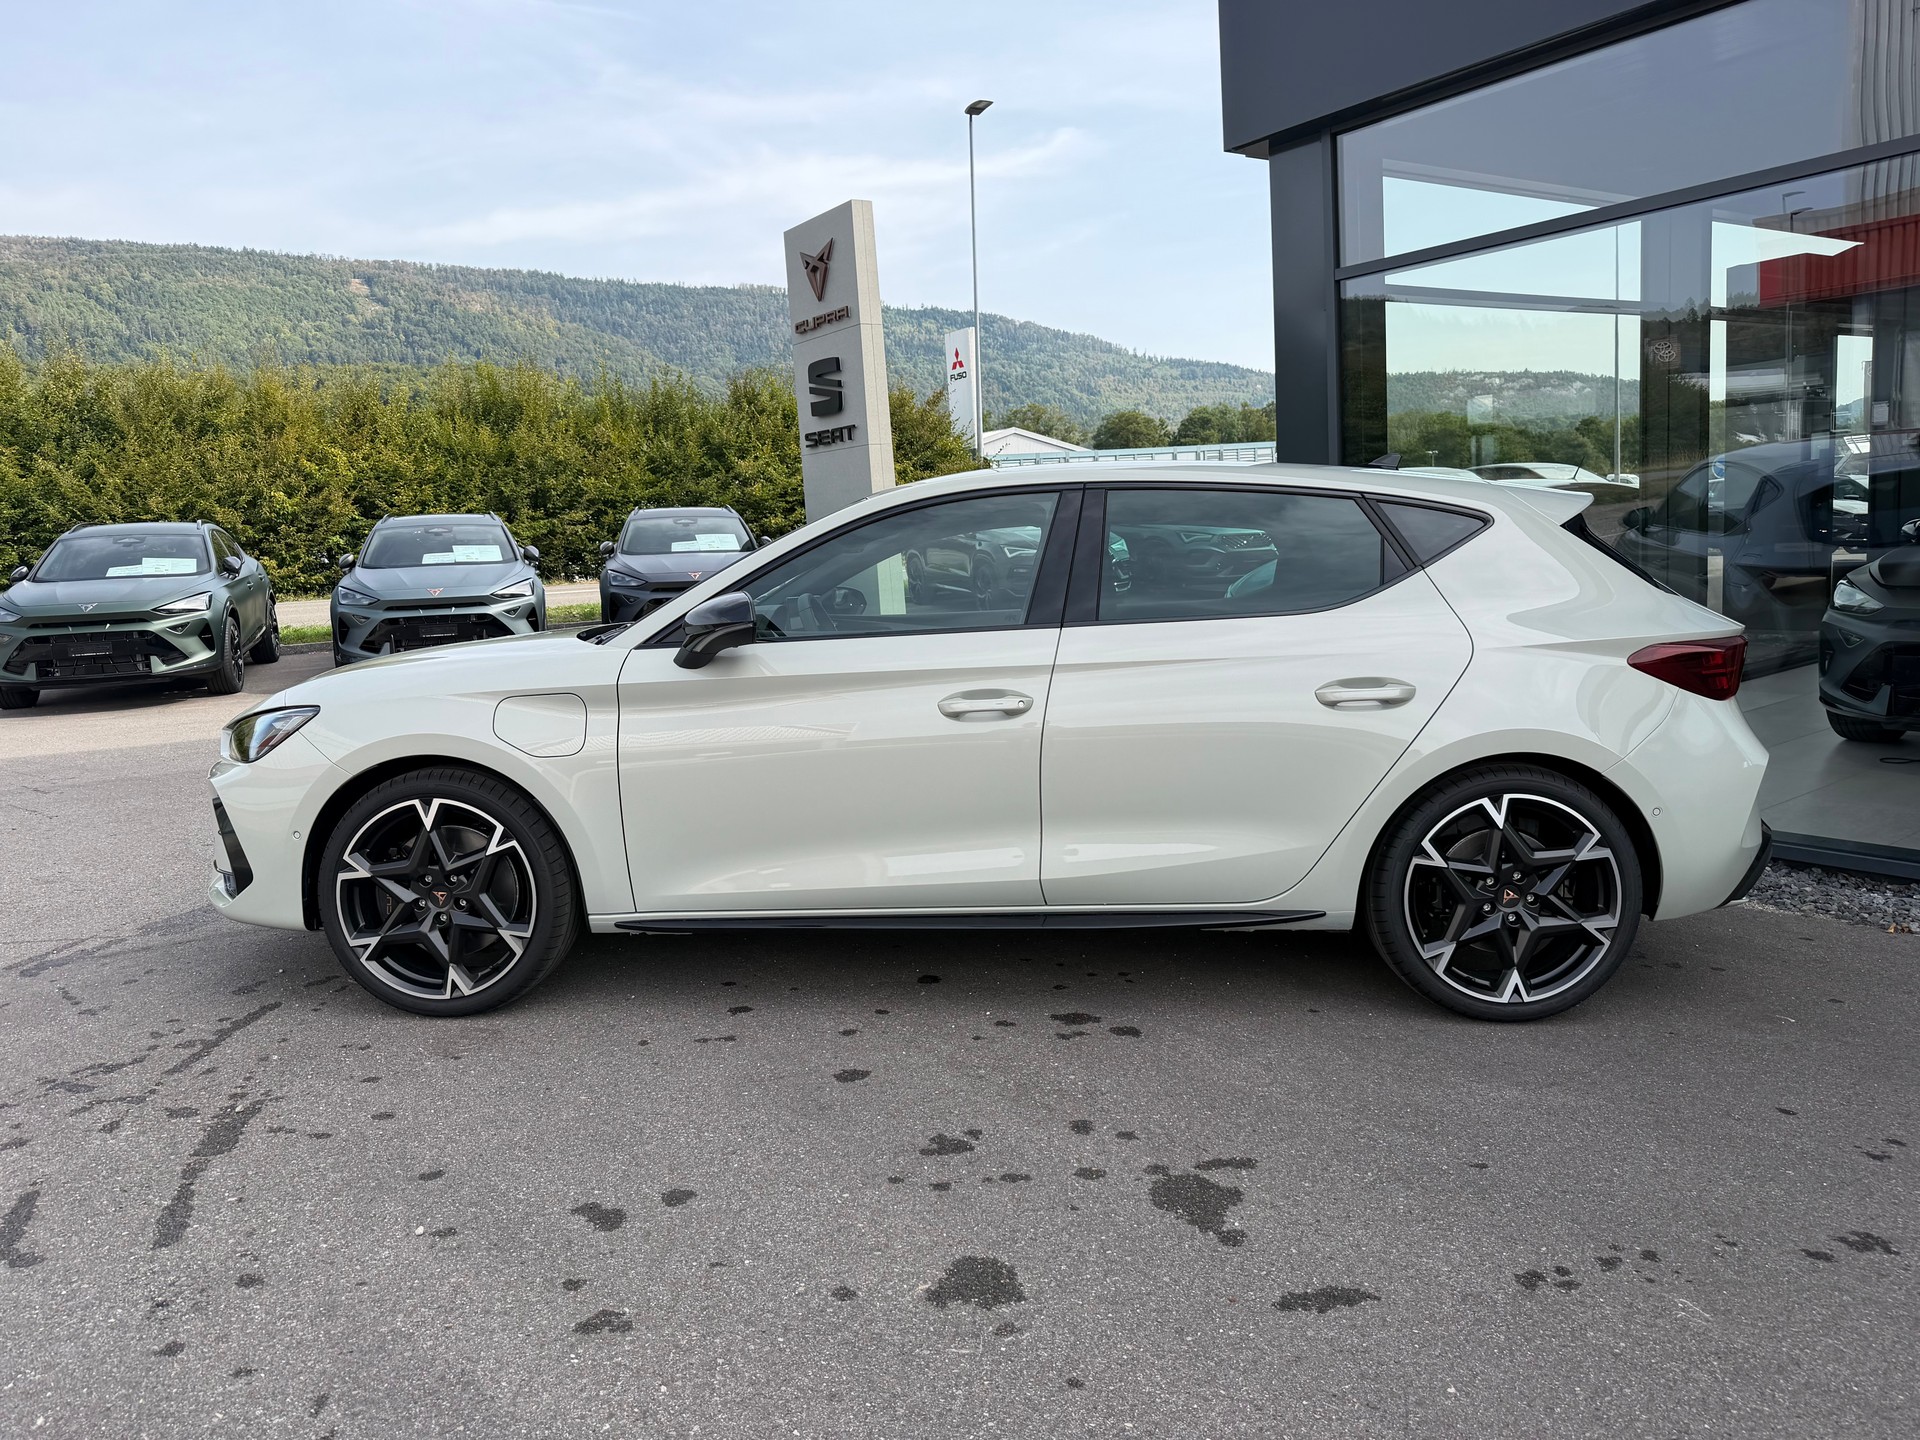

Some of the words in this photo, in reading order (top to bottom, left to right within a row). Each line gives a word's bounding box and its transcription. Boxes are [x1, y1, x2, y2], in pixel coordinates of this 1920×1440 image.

[795, 305, 850, 334] CUPRA
[950, 371, 967, 381] FUSO
[805, 424, 856, 448] SEAT
